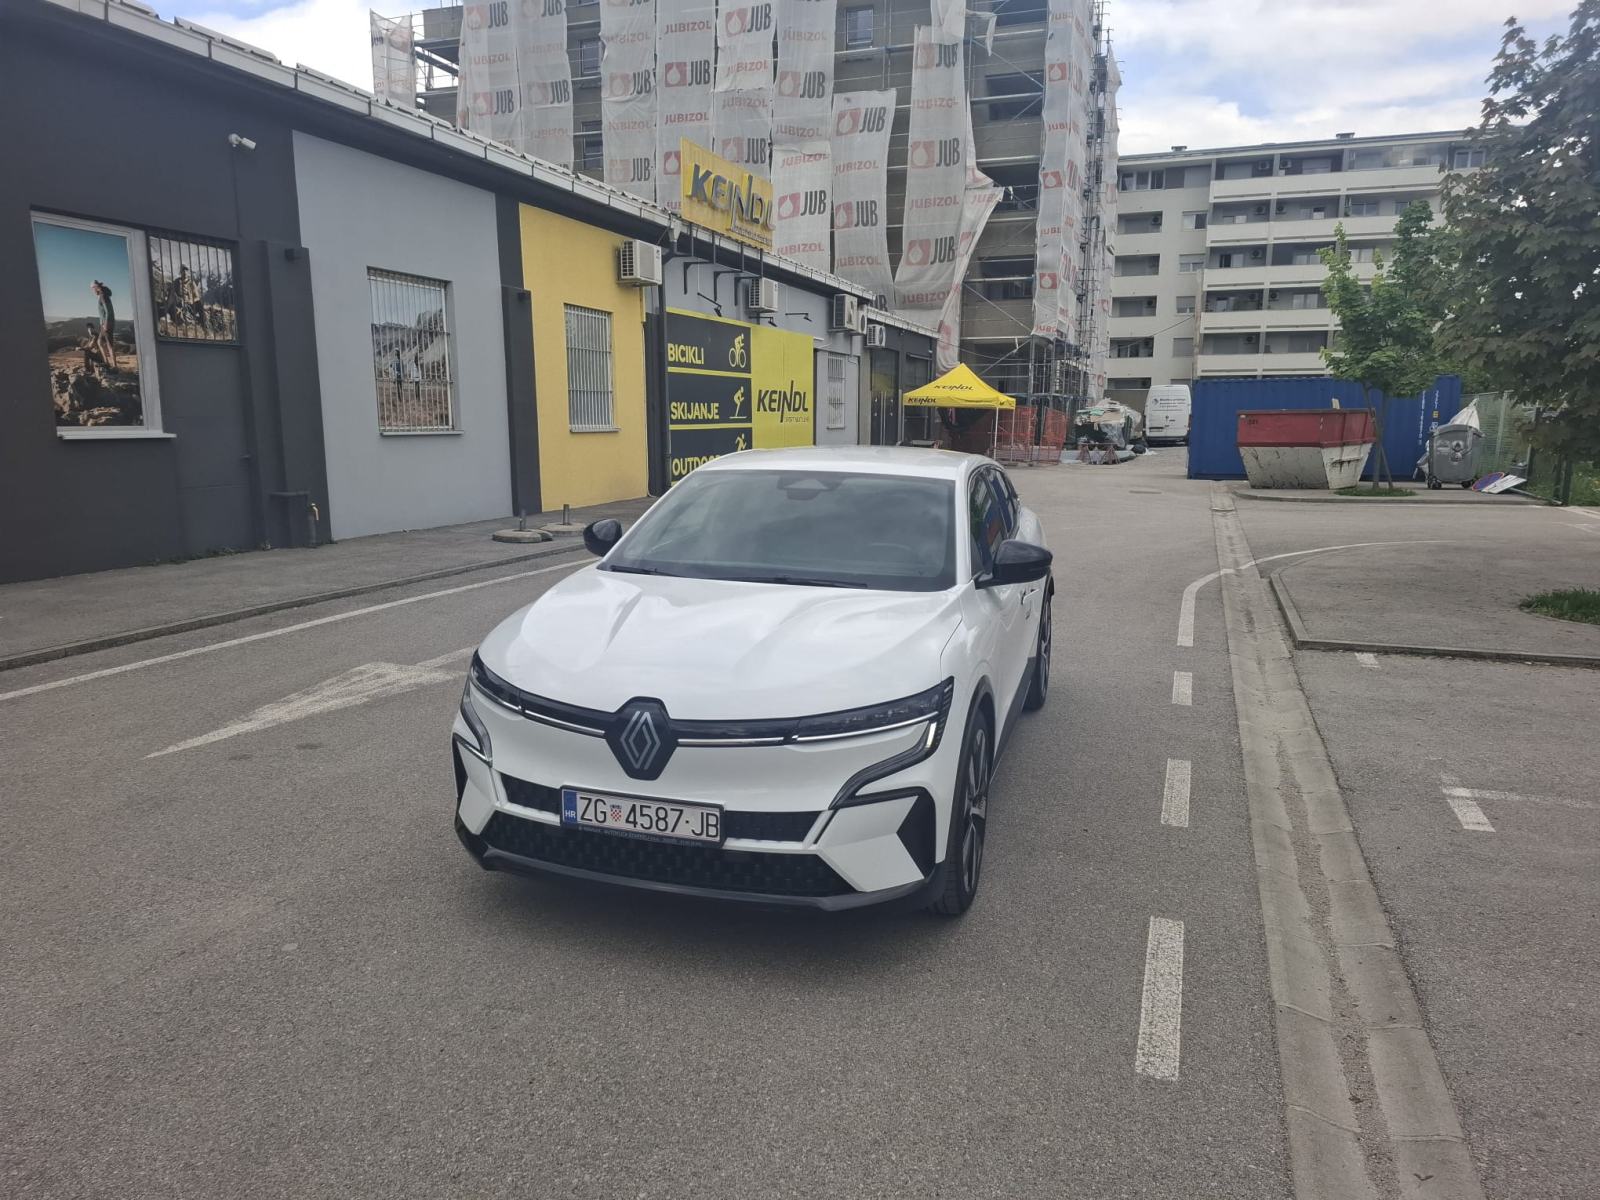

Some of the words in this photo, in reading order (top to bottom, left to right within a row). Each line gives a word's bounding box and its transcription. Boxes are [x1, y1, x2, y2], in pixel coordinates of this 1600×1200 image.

[488, 1, 508, 29] JUB
[664, 20, 711, 34] JUBIZOL
[747, 3, 771, 32] JUB
[629, 69, 651, 95] JUB
[688, 60, 710, 86] JUB
[800, 71, 825, 99] JUB
[494, 89, 514, 115] JUB
[550, 79, 570, 104] JUB
[664, 112, 709, 125] JUBIZOL
[776, 125, 823, 138] JUBIZOL
[859, 106, 886, 133] JUB
[744, 138, 766, 164] JUB
[936, 138, 960, 167] JUB
[631, 158, 651, 182] JUB
[835, 160, 880, 176] JUBIZOL
[688, 163, 775, 231] KEINDL
[800, 190, 827, 216] JUB
[909, 195, 960, 209] JUBIZOL
[854, 200, 878, 228] JUB
[777, 243, 824, 256] JUBIZOL
[836, 256, 881, 267] JUBIZOL
[930, 236, 955, 265] JUB
[667, 343, 705, 365] BICIKLI
[670, 401, 720, 420] SKIJANJE
[756, 380, 809, 423] KEINDL
[672, 454, 721, 477] OUTD
[564, 809, 577, 819] HR
[579, 796, 607, 824] ZG
